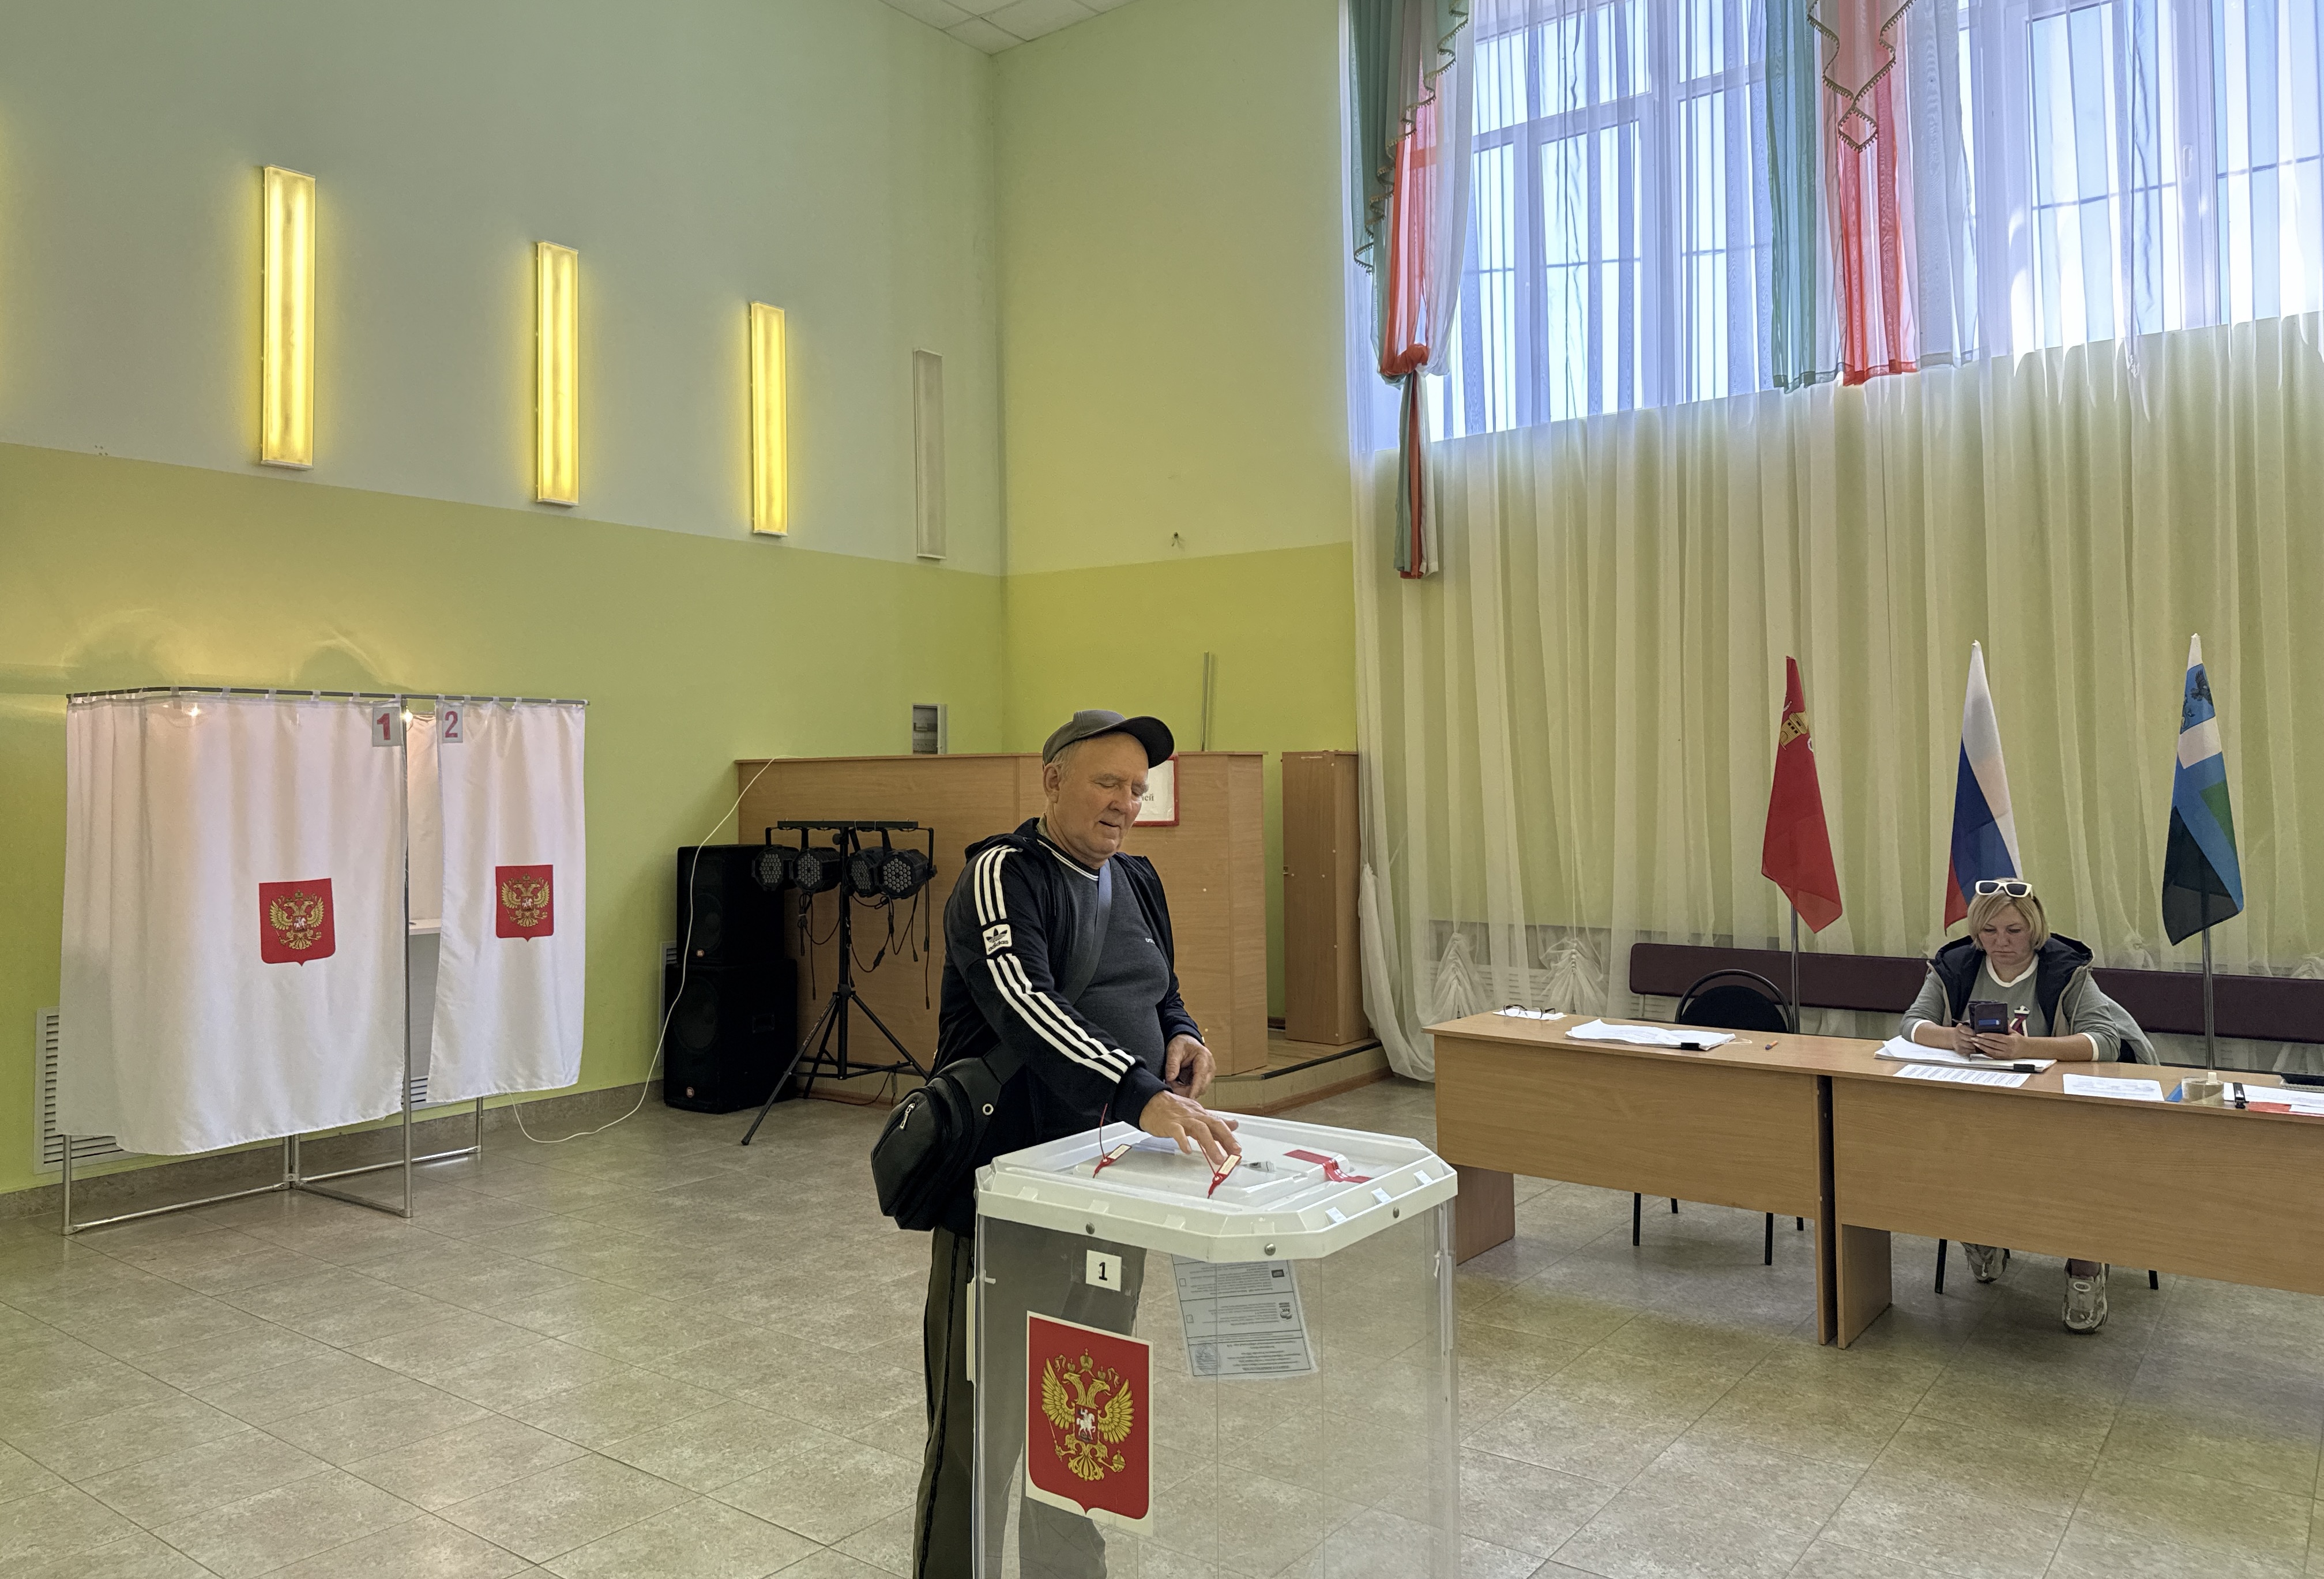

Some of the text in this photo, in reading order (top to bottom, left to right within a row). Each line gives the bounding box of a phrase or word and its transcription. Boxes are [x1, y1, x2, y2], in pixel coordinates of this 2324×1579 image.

[377, 713, 391, 740] 1
[445, 710, 458, 738] 2
[988, 940, 1009, 952] adidas
[1099, 1261, 1108, 1281] 1
